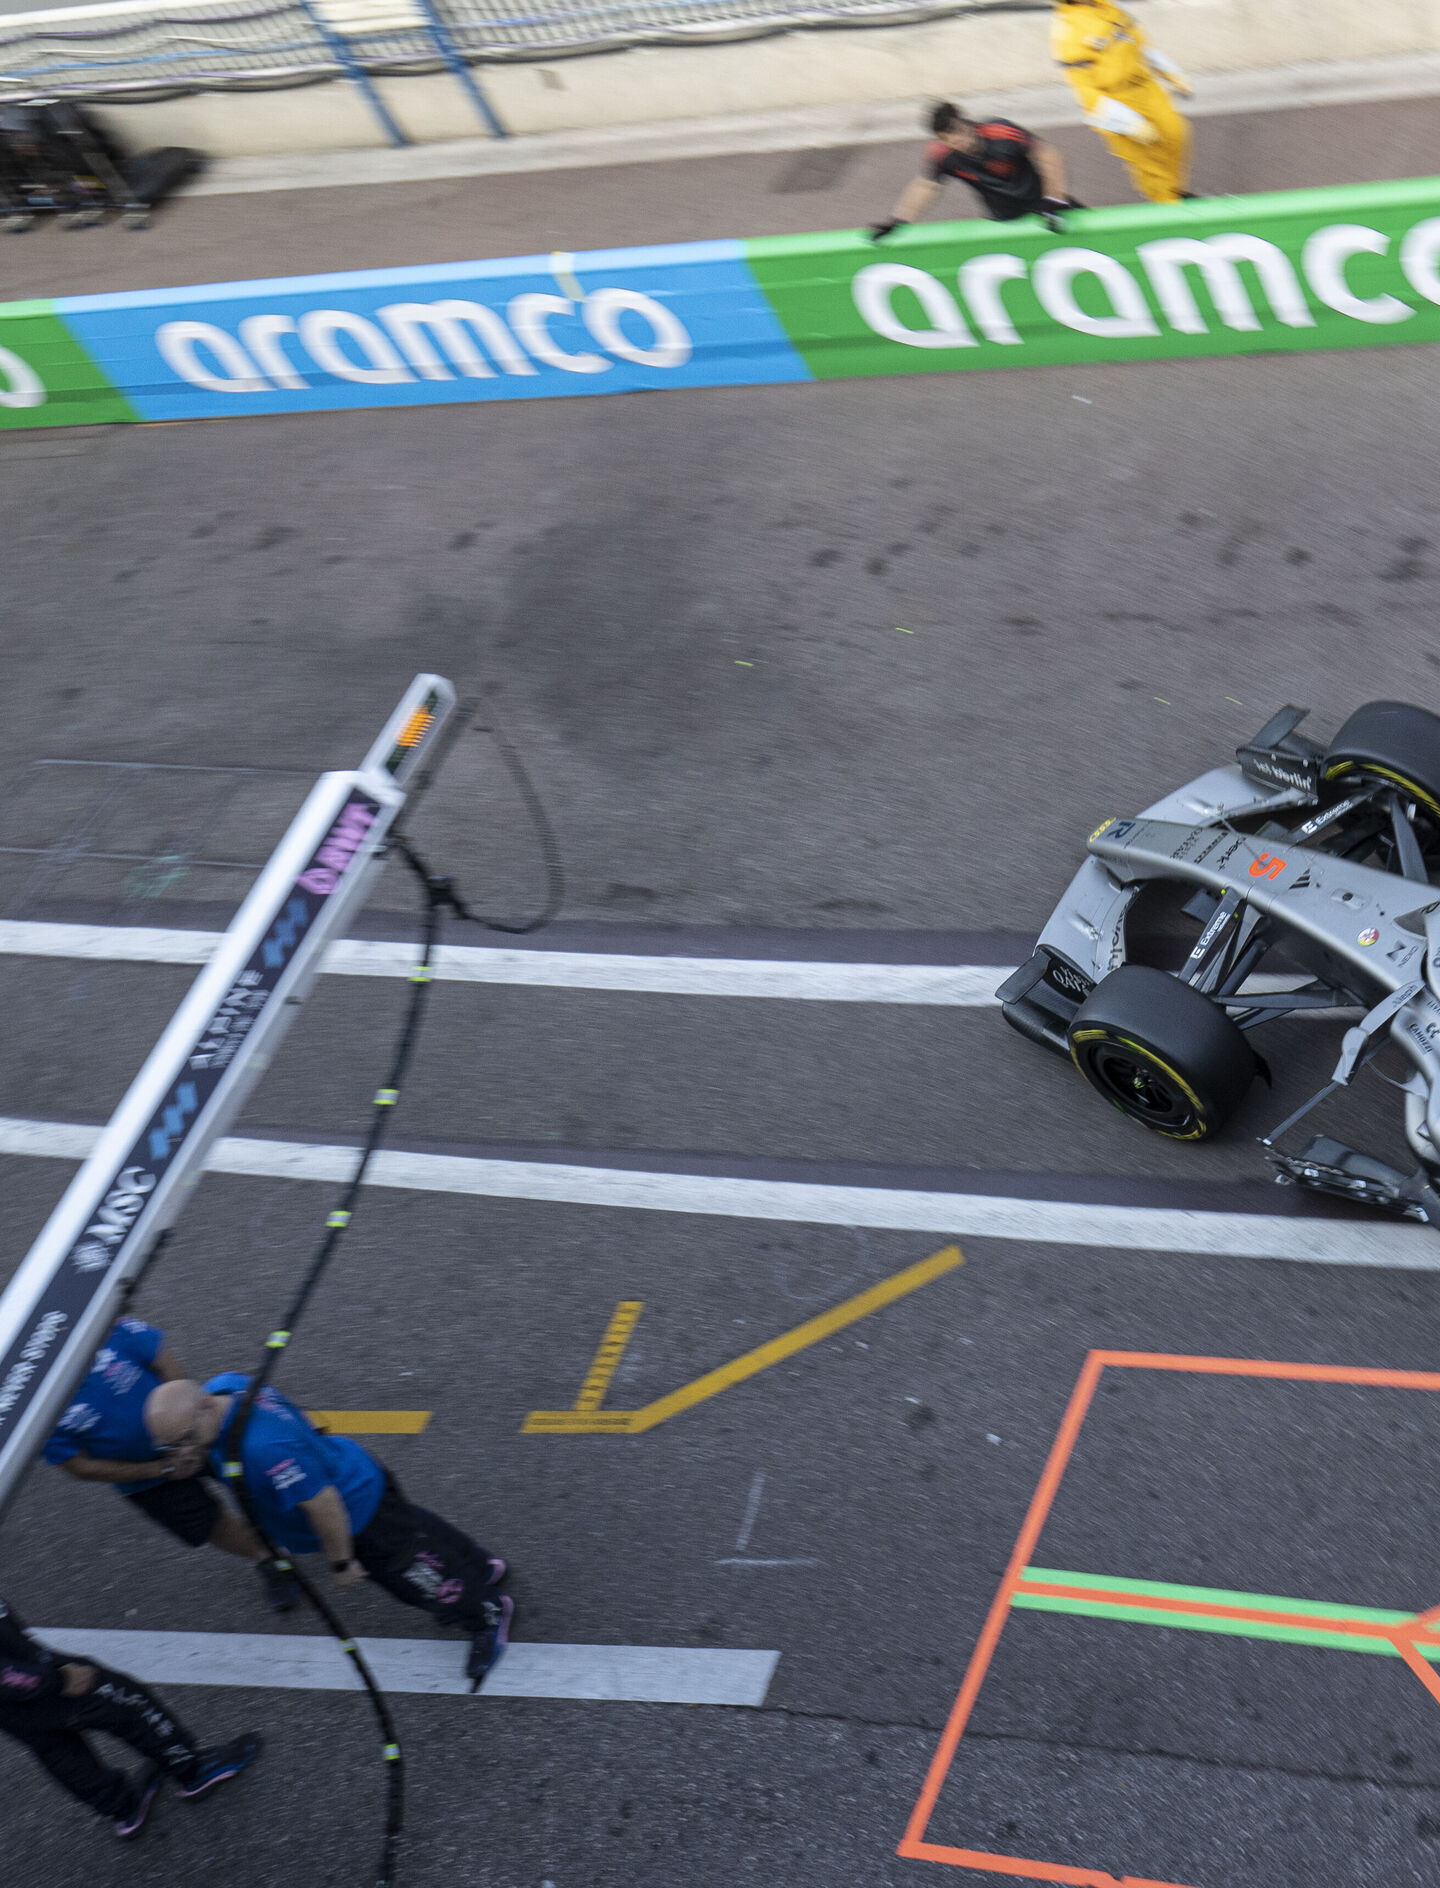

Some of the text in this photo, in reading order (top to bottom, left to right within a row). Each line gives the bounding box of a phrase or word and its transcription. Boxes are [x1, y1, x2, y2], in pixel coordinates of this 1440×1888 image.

[153, 288, 693, 392] aramco
[1249, 852, 1287, 881] 5
[1201, 912, 1228, 946] Extreme
[86, 1165, 157, 1252] MSC
